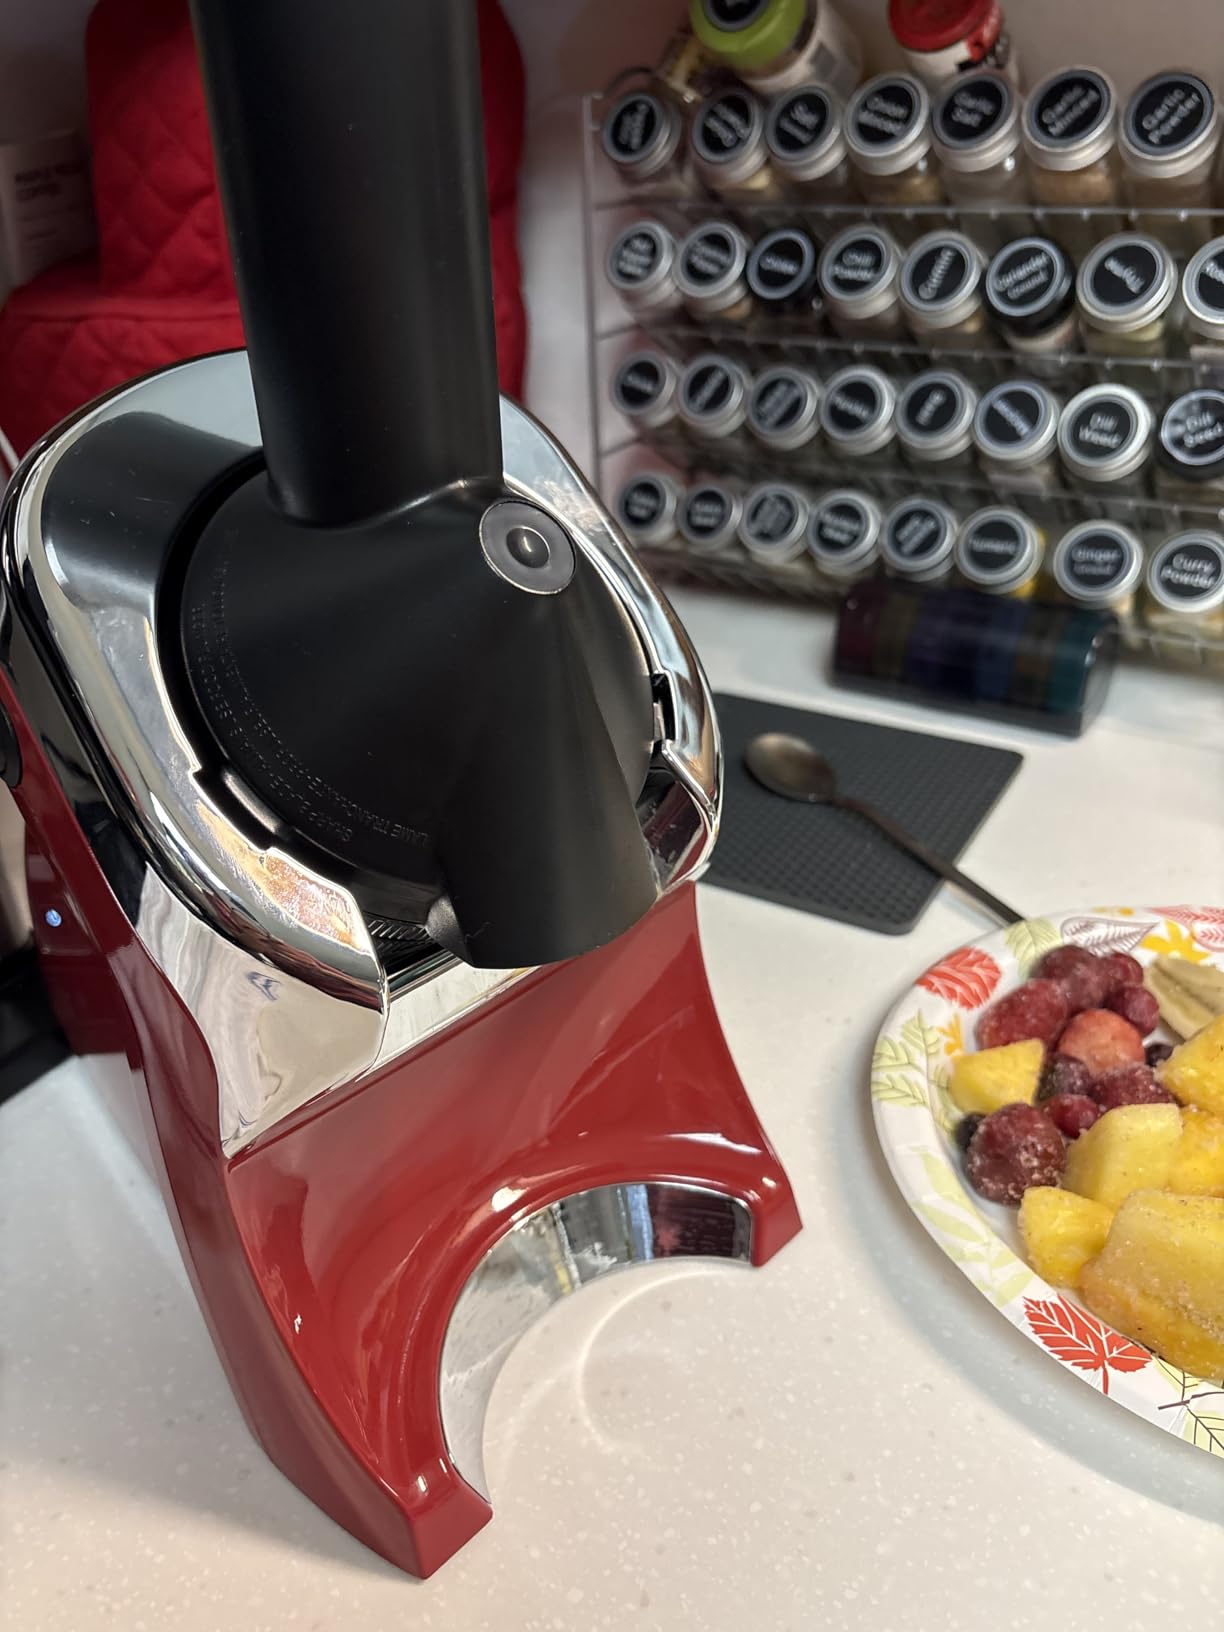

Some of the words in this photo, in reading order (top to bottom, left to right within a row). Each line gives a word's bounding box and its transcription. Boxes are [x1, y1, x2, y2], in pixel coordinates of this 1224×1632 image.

[1141, 88, 1187, 131] Garlic
[1147, 92, 1202, 145] Powder
[1089, 412, 1118, 432] Dill
[1185, 412, 1216, 431] Dill
[1078, 424, 1123, 449] Weed
[1071, 546, 1121, 563] Ginger
[1172, 552, 1216, 573] Curry
[1160, 564, 1217, 590] Powder
